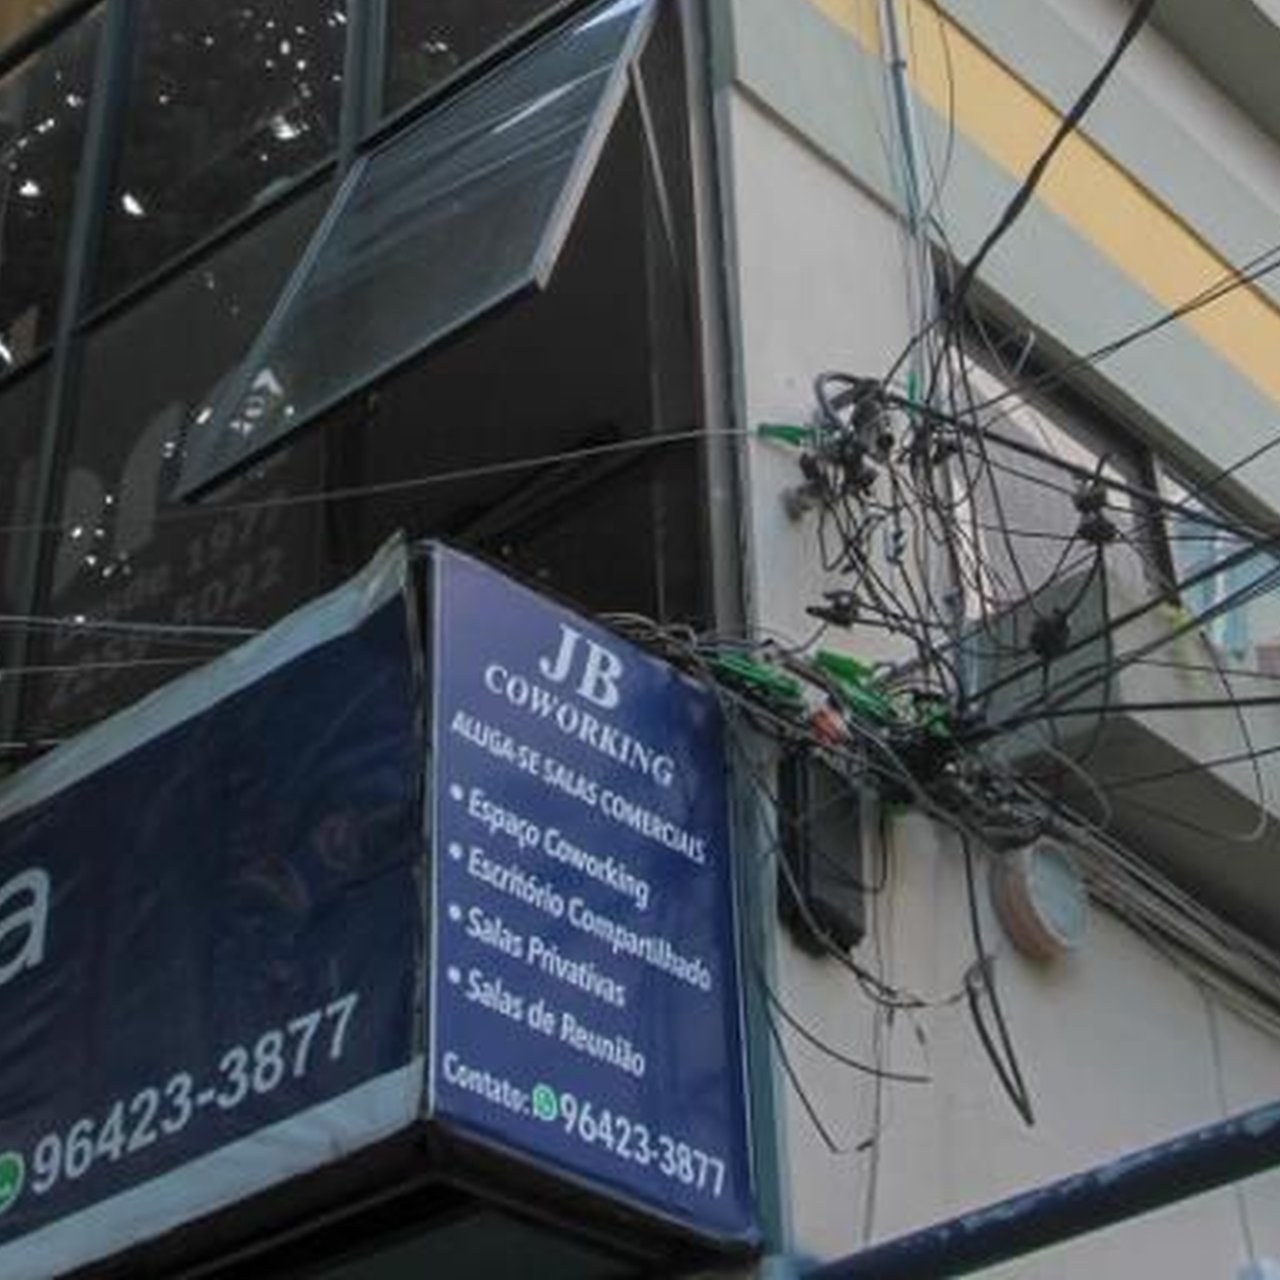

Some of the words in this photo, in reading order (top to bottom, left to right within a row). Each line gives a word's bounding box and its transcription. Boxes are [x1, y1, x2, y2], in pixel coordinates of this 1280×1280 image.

[484, 664, 675, 787] COWORKING
[539, 623, 623, 709] JB
[469, 787, 540, 848] Espaço
[543, 828, 650, 910] Coworking
[543, 757, 599, 806] SALAS
[600, 789, 706, 864] COMERCIAIS
[466, 906, 523, 958] Salas
[527, 936, 626, 1007] Privativas
[469, 848, 565, 918] Escritório
[569, 898, 713, 991] Compartilhado
[466, 969, 523, 1021] Salas
[528, 999, 556, 1035] de
[560, 1013, 646, 1077] Reunião
[32, 992, 360, 1195] 96423-3877
[442, 1051, 531, 1115] Contato:
[560, 1092, 725, 1195] 96423-3877
